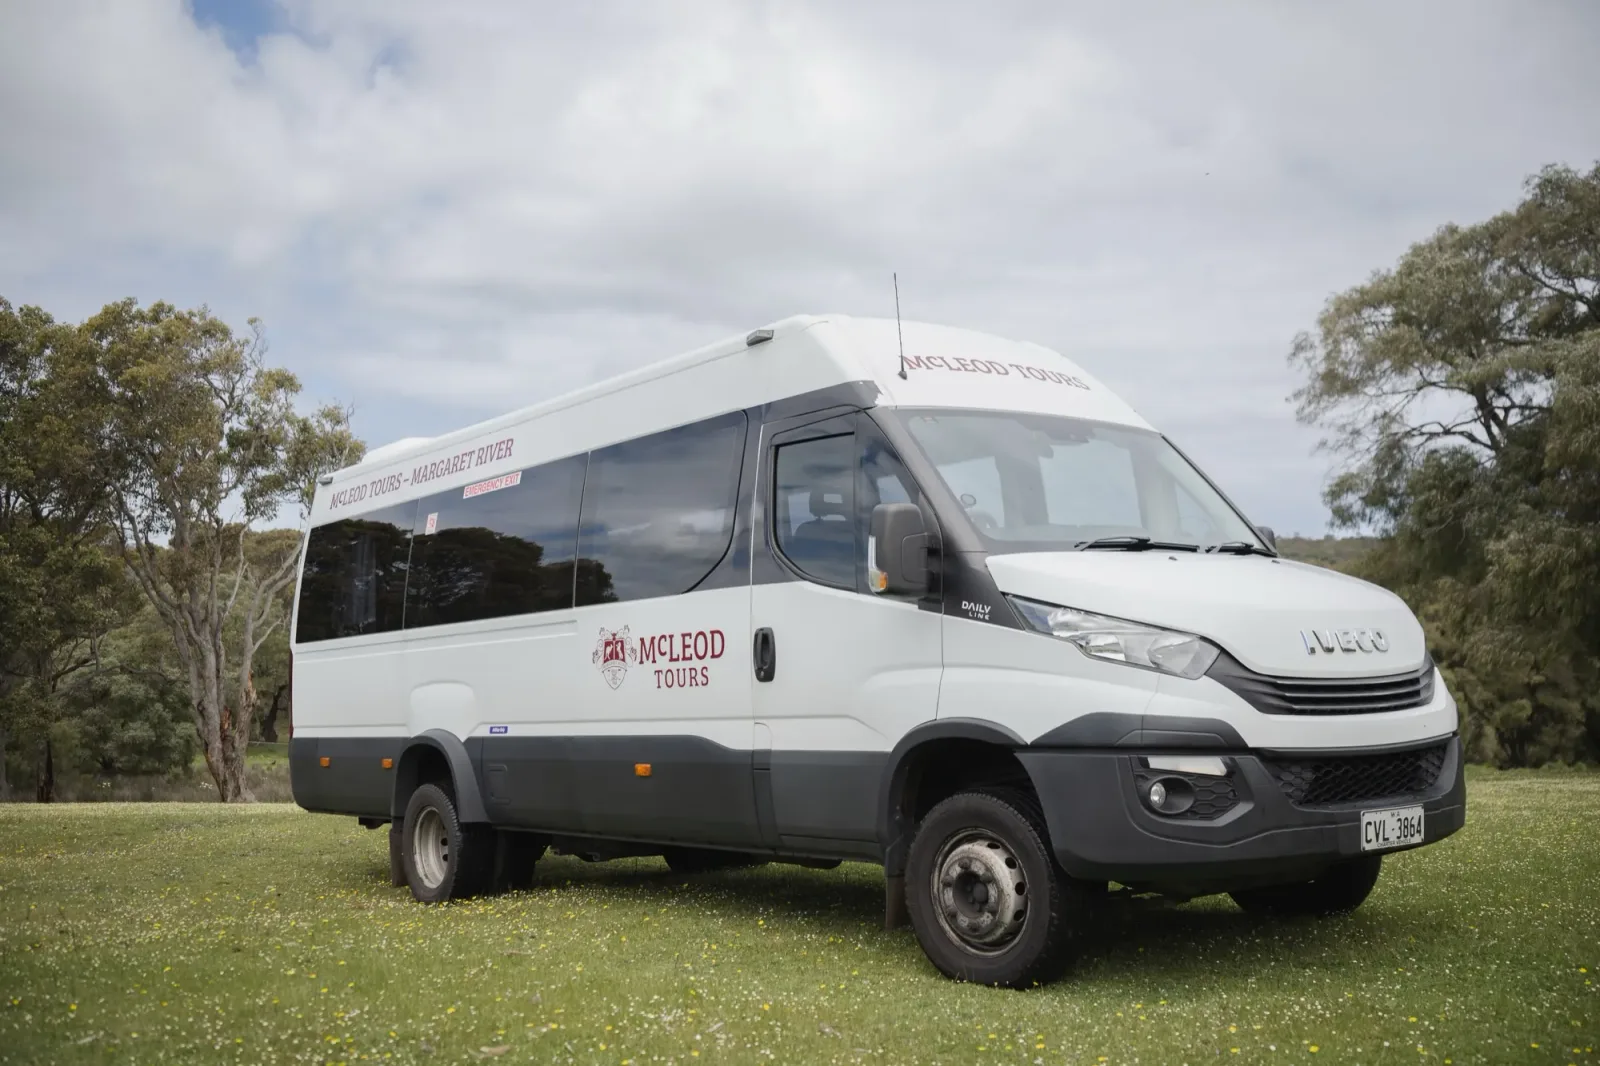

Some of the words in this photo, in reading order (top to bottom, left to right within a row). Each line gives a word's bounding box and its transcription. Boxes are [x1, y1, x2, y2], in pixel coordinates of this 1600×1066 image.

[1008, 363, 1091, 391] TOURS
[368, 472, 402, 499] TOURS
[410, 450, 475, 486] MARGARET
[475, 438, 514, 467] RIVER
[464, 478, 502, 497] EMERGENCY
[504, 473, 520, 485] EXIT
[961, 600, 991, 613] DAILY
[968, 611, 990, 620] LINE
[1300, 628, 1390, 656] IVECO
[654, 666, 709, 689] TOURS
